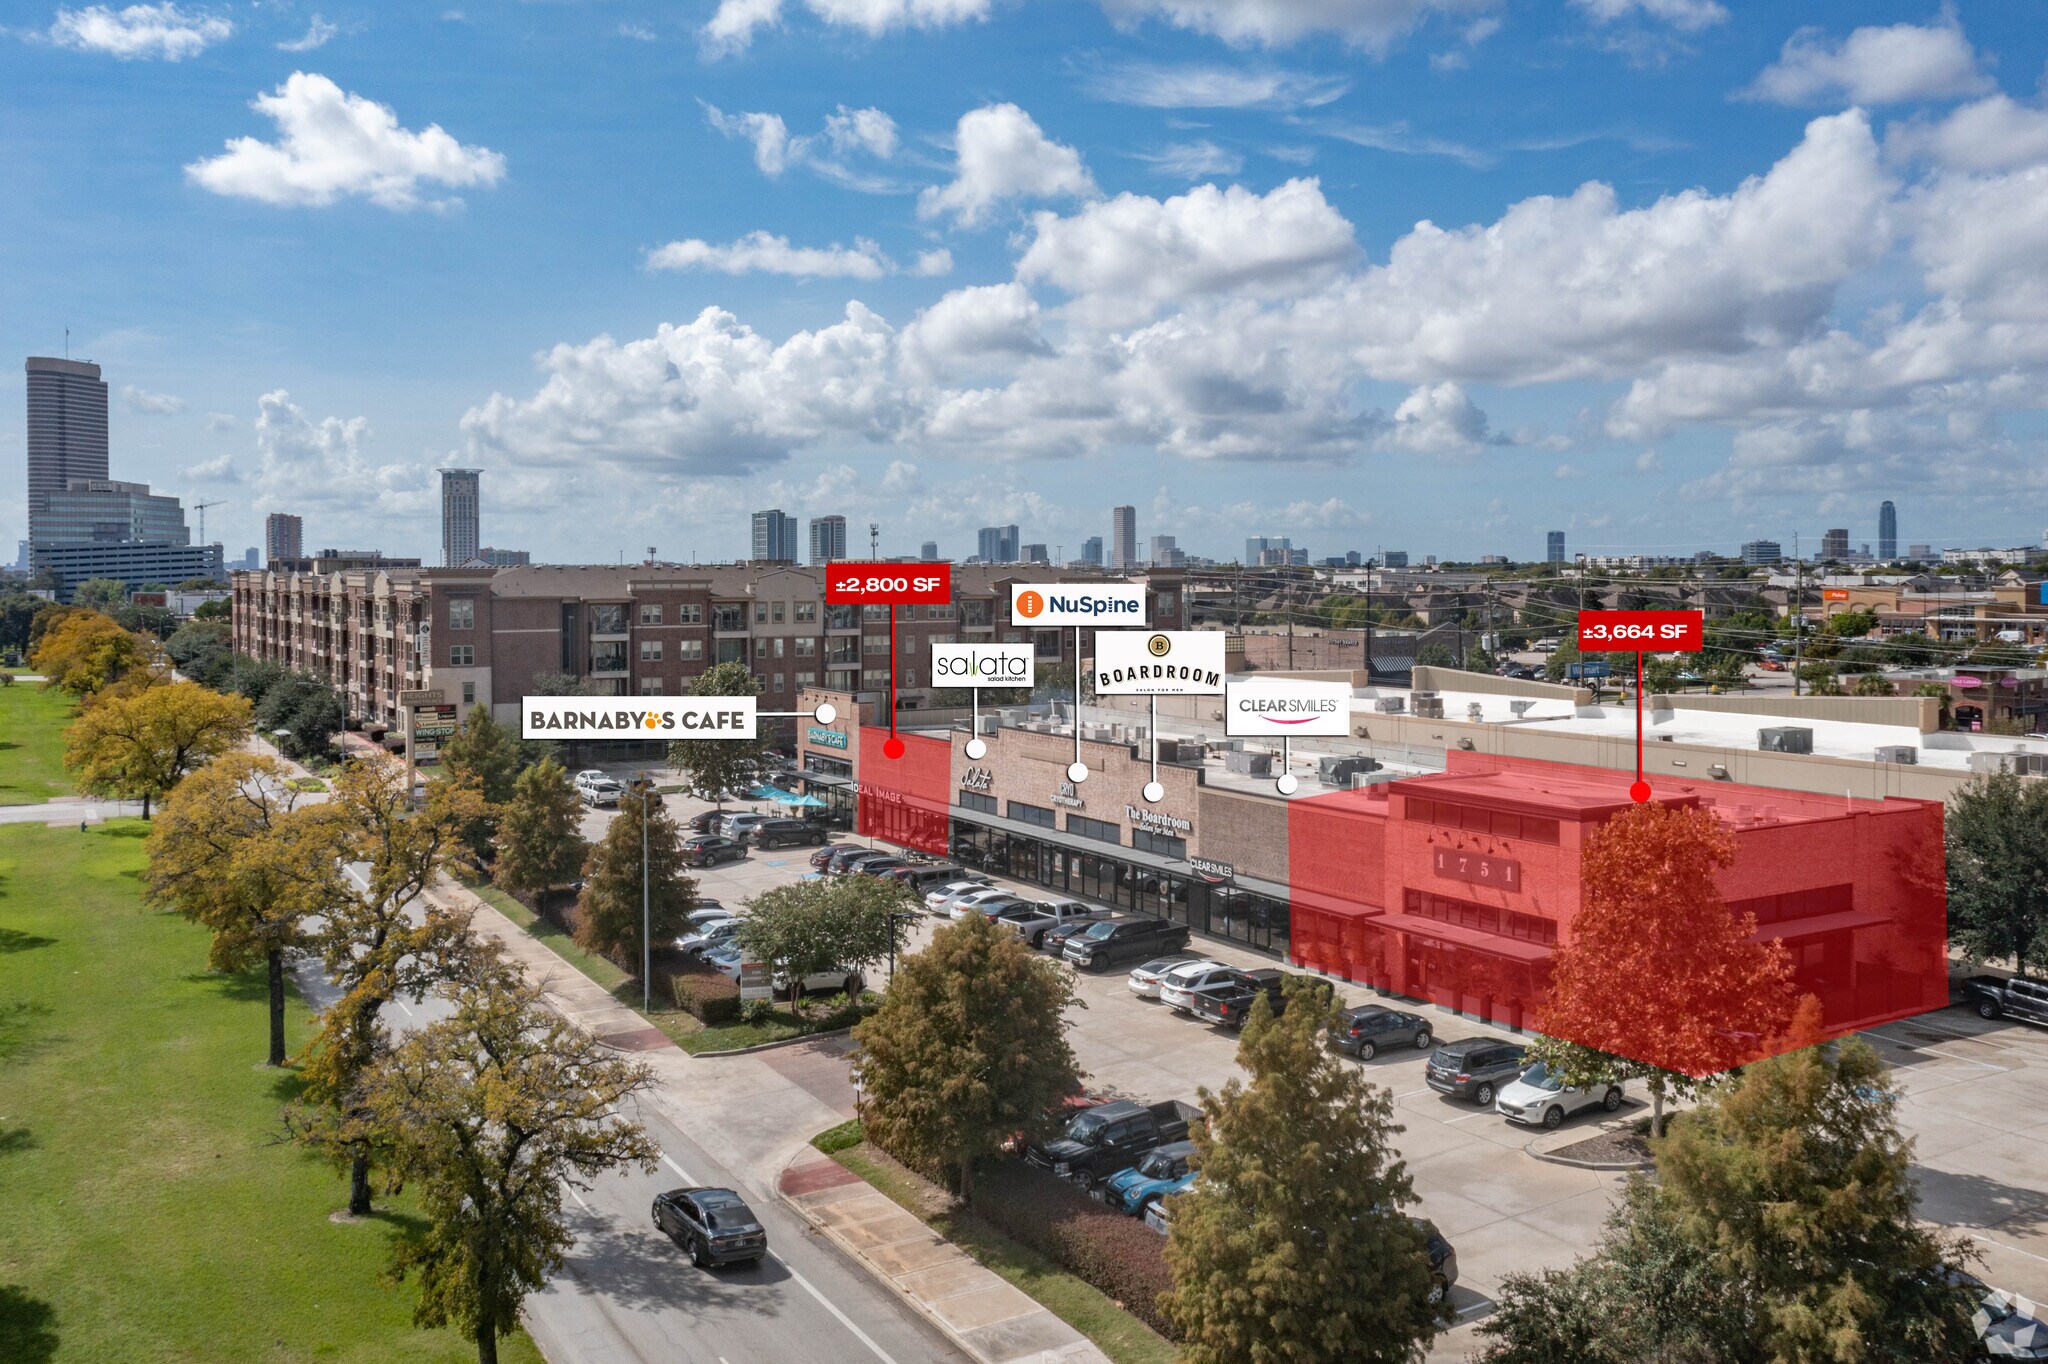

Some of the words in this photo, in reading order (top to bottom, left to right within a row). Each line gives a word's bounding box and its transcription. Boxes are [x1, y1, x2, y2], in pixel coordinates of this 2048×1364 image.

[1572, 665, 1600, 675] Wmart
[402, 691, 442, 699] HEIGHTS
[831, 734, 844, 746] CAFE
[961, 767, 991, 790] Salata
[1125, 805, 1140, 820] The
[1142, 809, 1190, 831] Boardroom
[1190, 858, 1211, 871] CLEAR
[1211, 863, 1233, 878] SMILES
